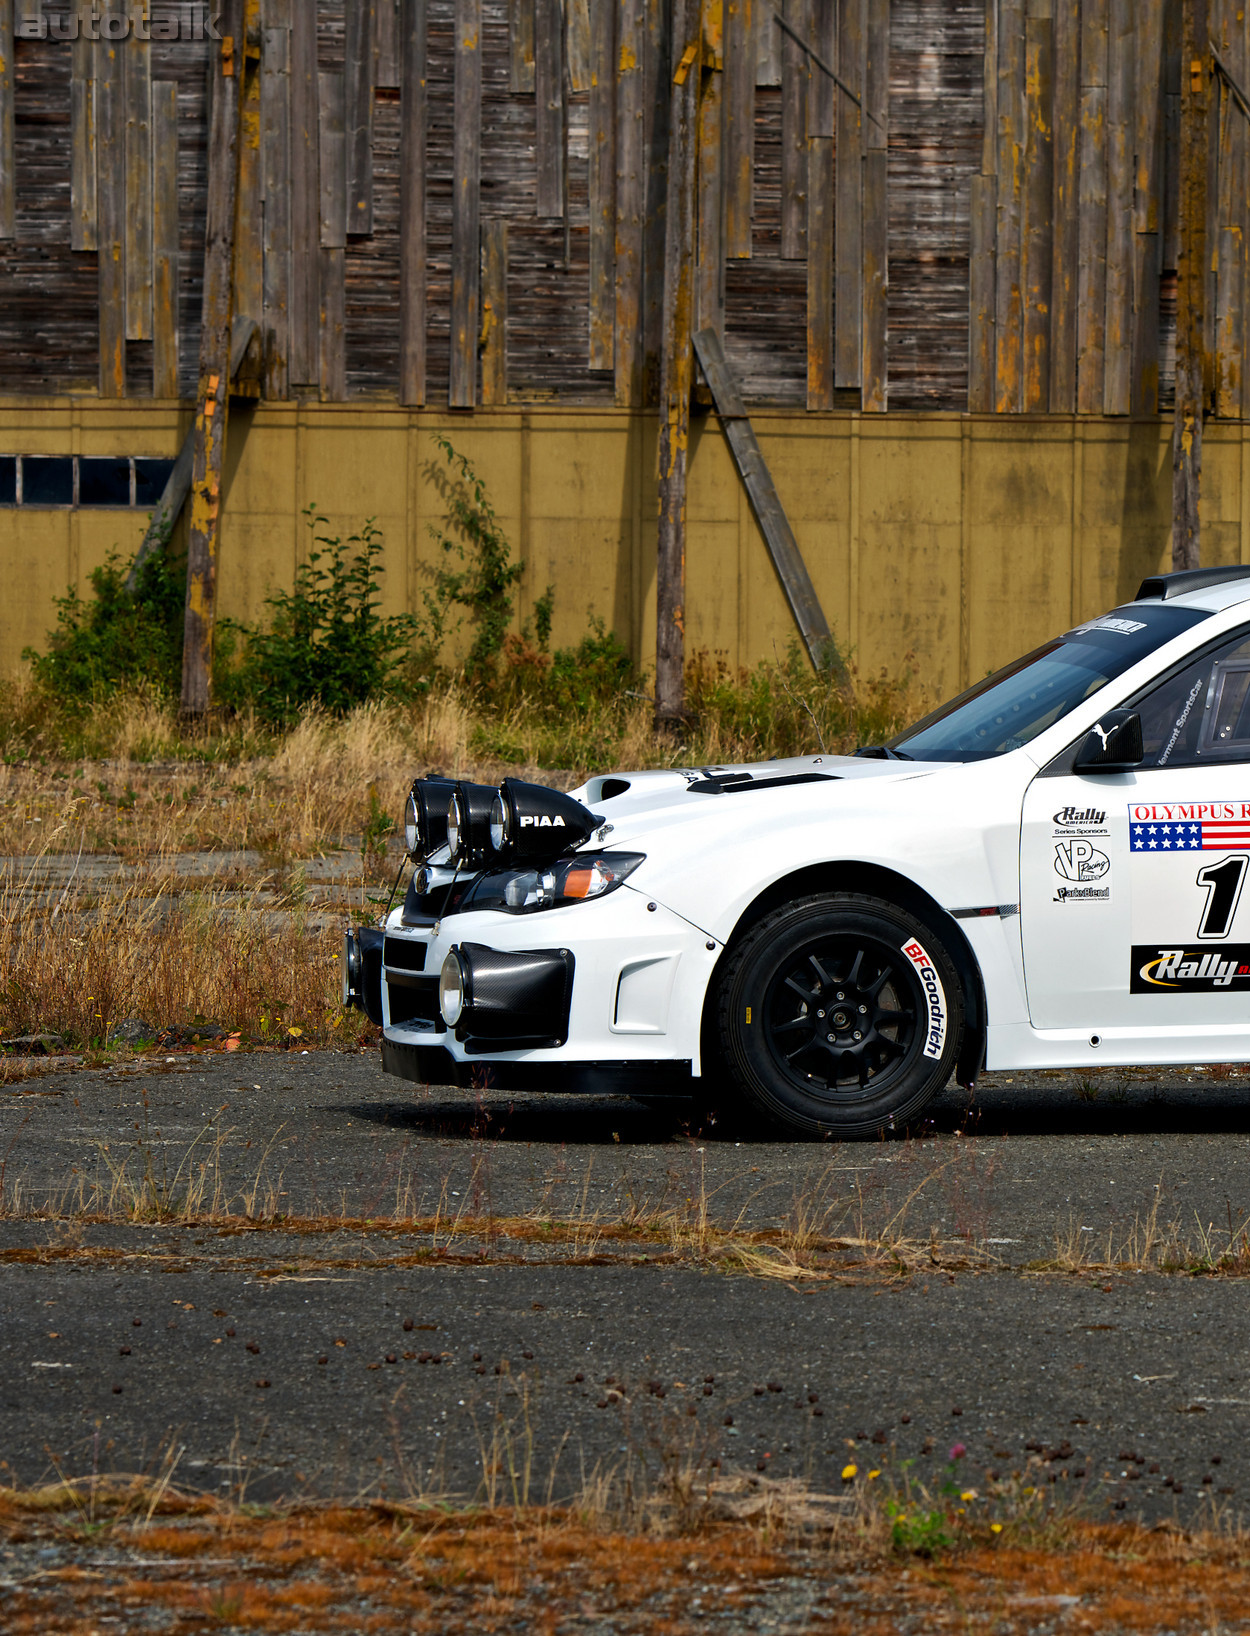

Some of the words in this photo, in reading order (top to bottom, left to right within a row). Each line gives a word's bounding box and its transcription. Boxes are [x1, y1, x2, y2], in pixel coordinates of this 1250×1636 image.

[1062, 806, 1106, 824] Rally
[1134, 803, 1235, 821] OLYMPUS
[520, 815, 566, 828] PIAA
[1077, 828, 1108, 836] Sponsors
[1196, 854, 1250, 939] 1
[1154, 949, 1239, 986] Rally
[904, 943, 945, 1056] BFGoodrich
